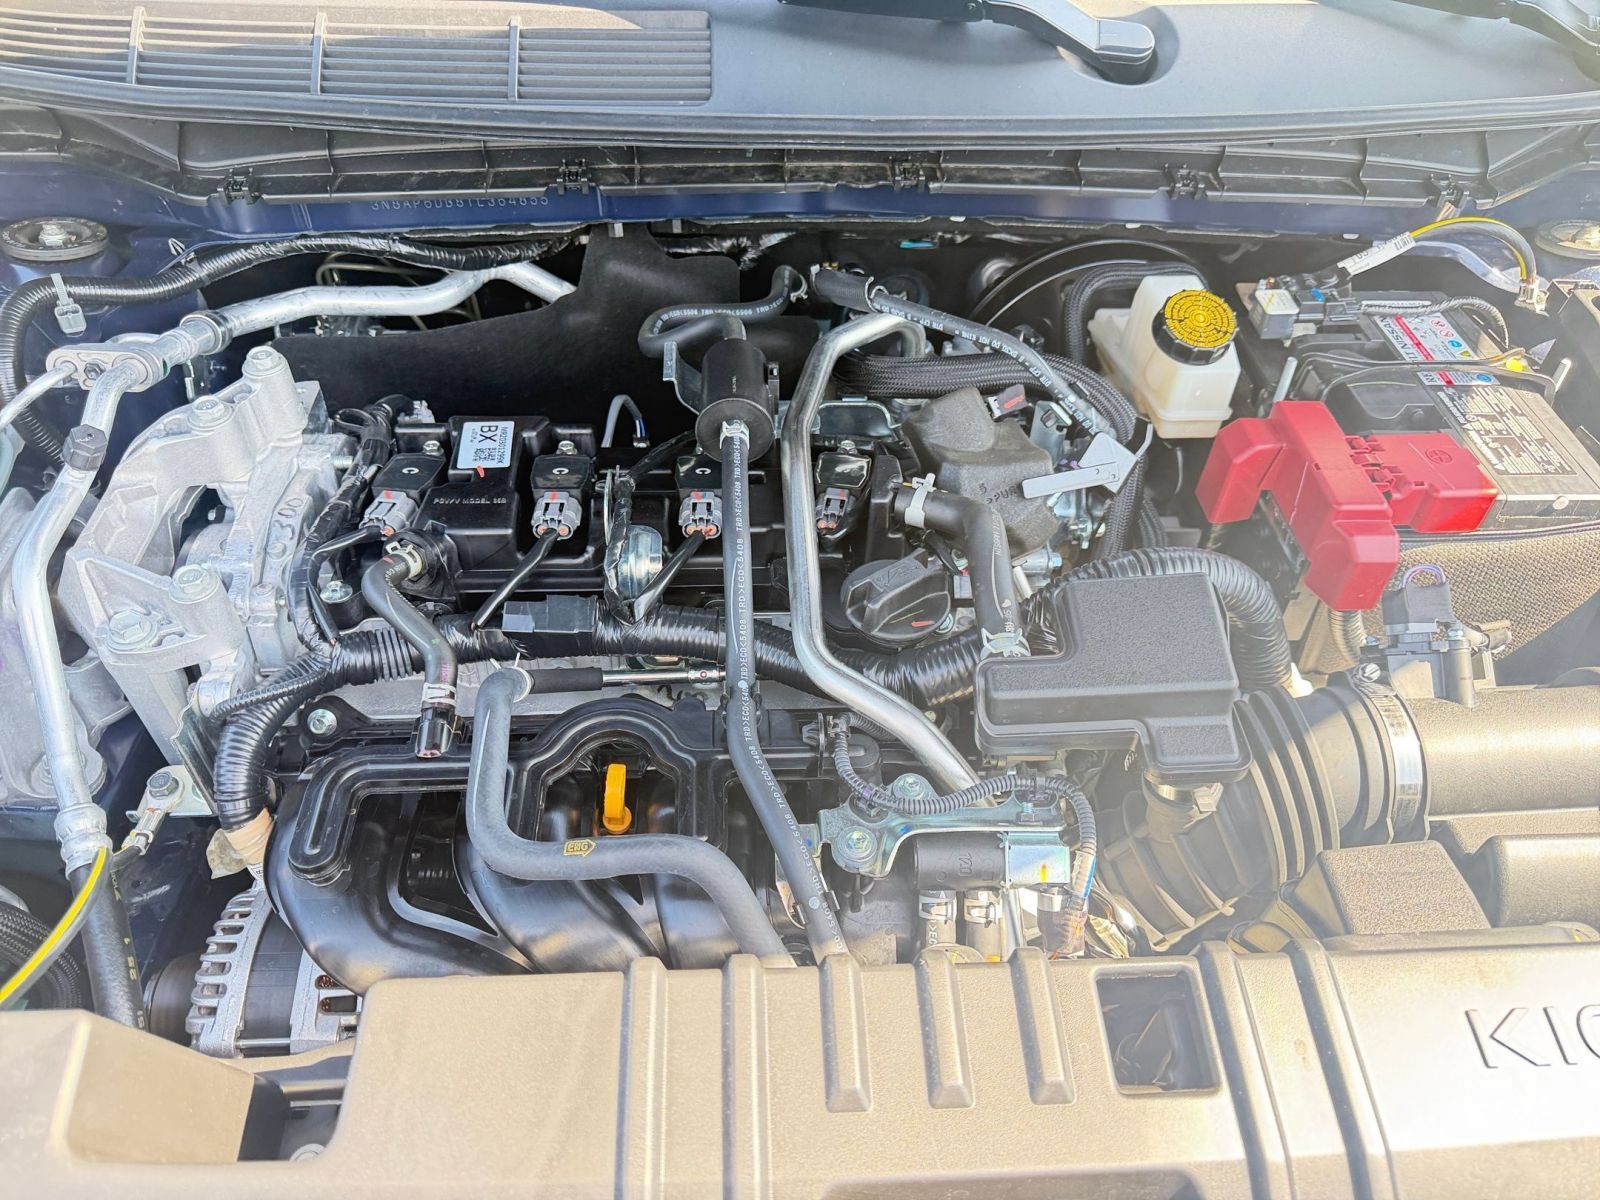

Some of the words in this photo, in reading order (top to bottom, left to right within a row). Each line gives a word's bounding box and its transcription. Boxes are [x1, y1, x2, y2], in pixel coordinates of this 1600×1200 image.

[478, 425, 499, 443] BX
[402, 467, 420, 475] C
[552, 467, 570, 475] C
[695, 467, 712, 475] C
[740, 686, 753, 742] TRD>ECO<540
[567, 841, 589, 852] ENG
